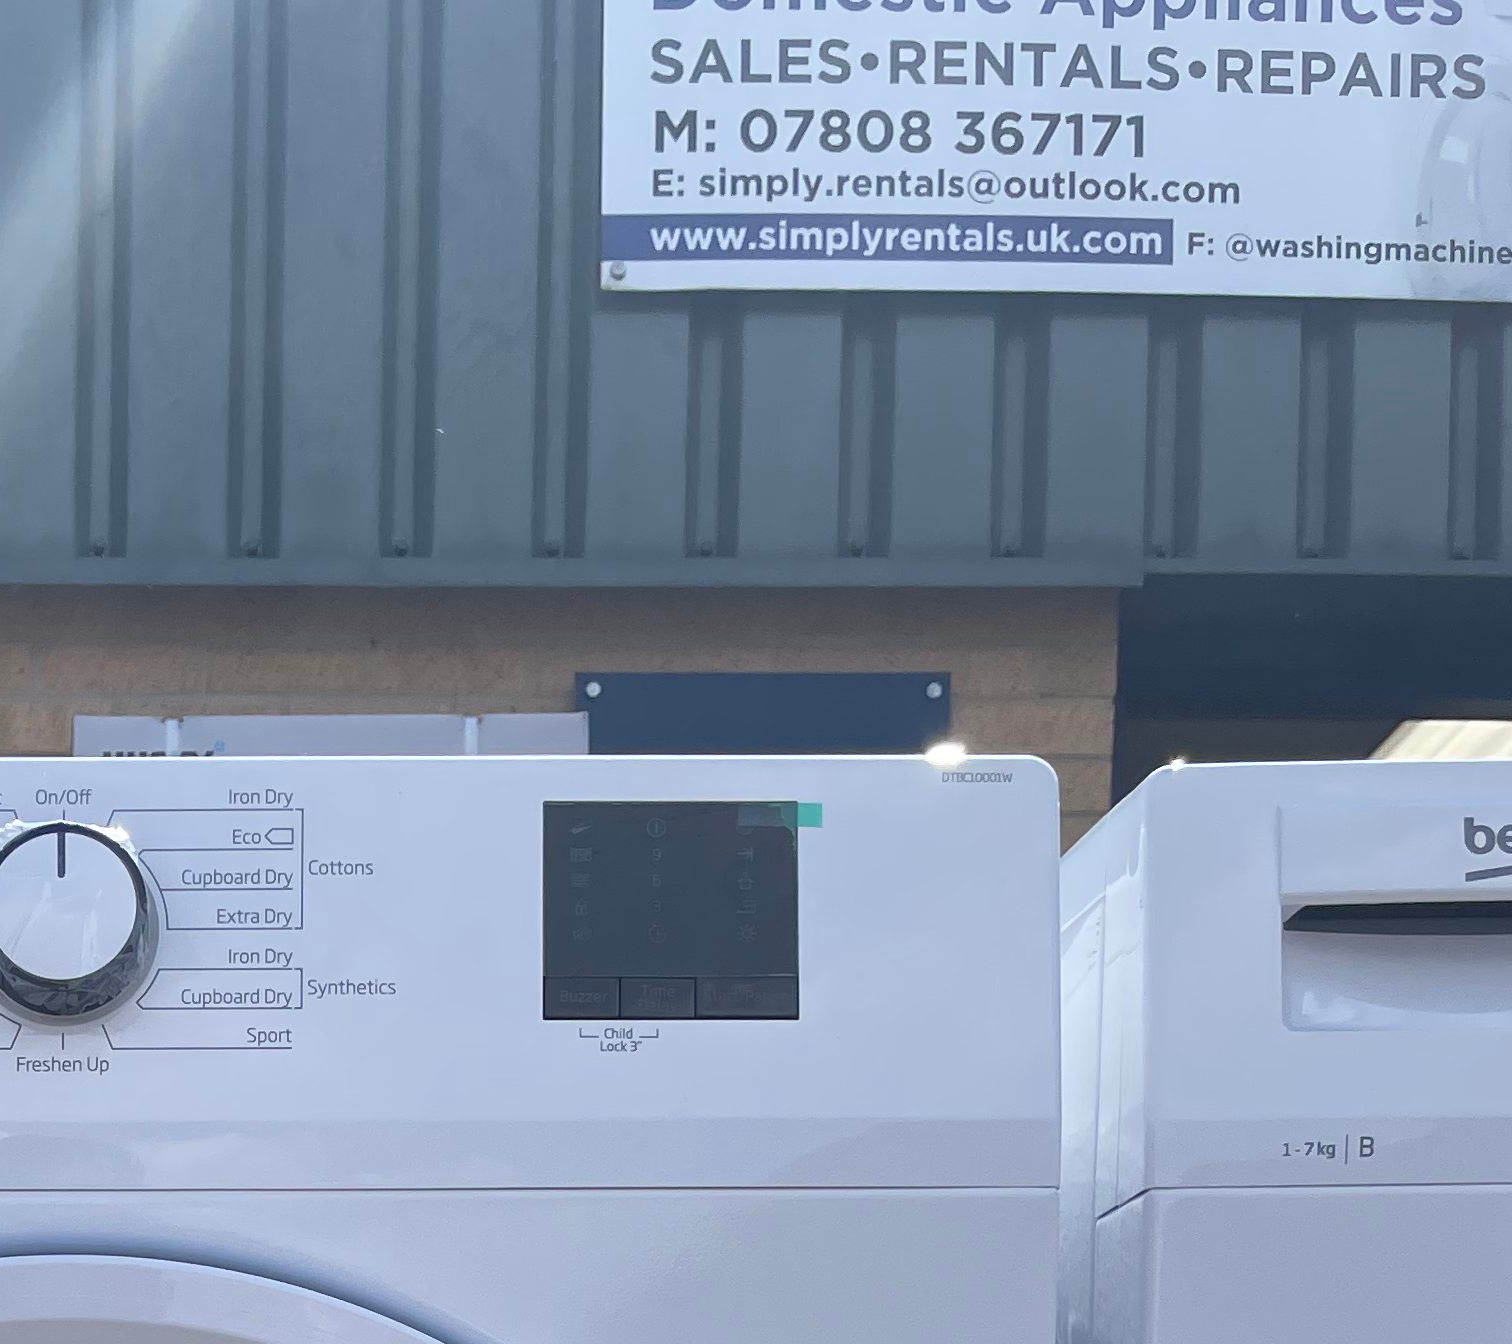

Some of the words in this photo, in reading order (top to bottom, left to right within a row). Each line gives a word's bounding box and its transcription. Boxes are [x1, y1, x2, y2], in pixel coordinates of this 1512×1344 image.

[655, 110, 715, 153] M:
[741, 109, 931, 153] 07808
[955, 111, 1143, 157] 367171
[653, 169, 684, 196] E:
[700, 168, 1239, 204] simply.rentals@outlook.com
[650, 220, 1162, 257] www.simplyrentals.uk.com
[1188, 233, 1213, 255] F:
[36, 789, 92, 805] On/Off
[229, 789, 260, 804] Iron
[265, 789, 293, 808] Dry
[233, 829, 261, 844] Eco
[309, 860, 373, 875] Cottons
[181, 869, 260, 887] Cupboard
[265, 869, 293, 888] Dry
[216, 909, 259, 924] Extra
[264, 909, 293, 927] Dry
[229, 949, 259, 964] Iron
[265, 949, 293, 967] Dry
[308, 979, 396, 998] Synthetics
[181, 989, 260, 1006] Cupboard
[264, 989, 293, 1007] Dry
[247, 1028, 292, 1046] Sport
[604, 1028, 633, 1039] Child
[600, 1041, 627, 1052] Lock
[17, 1056, 82, 1072] Freshen
[87, 1057, 109, 1075] Up
[1359, 1136, 1374, 1157] B
